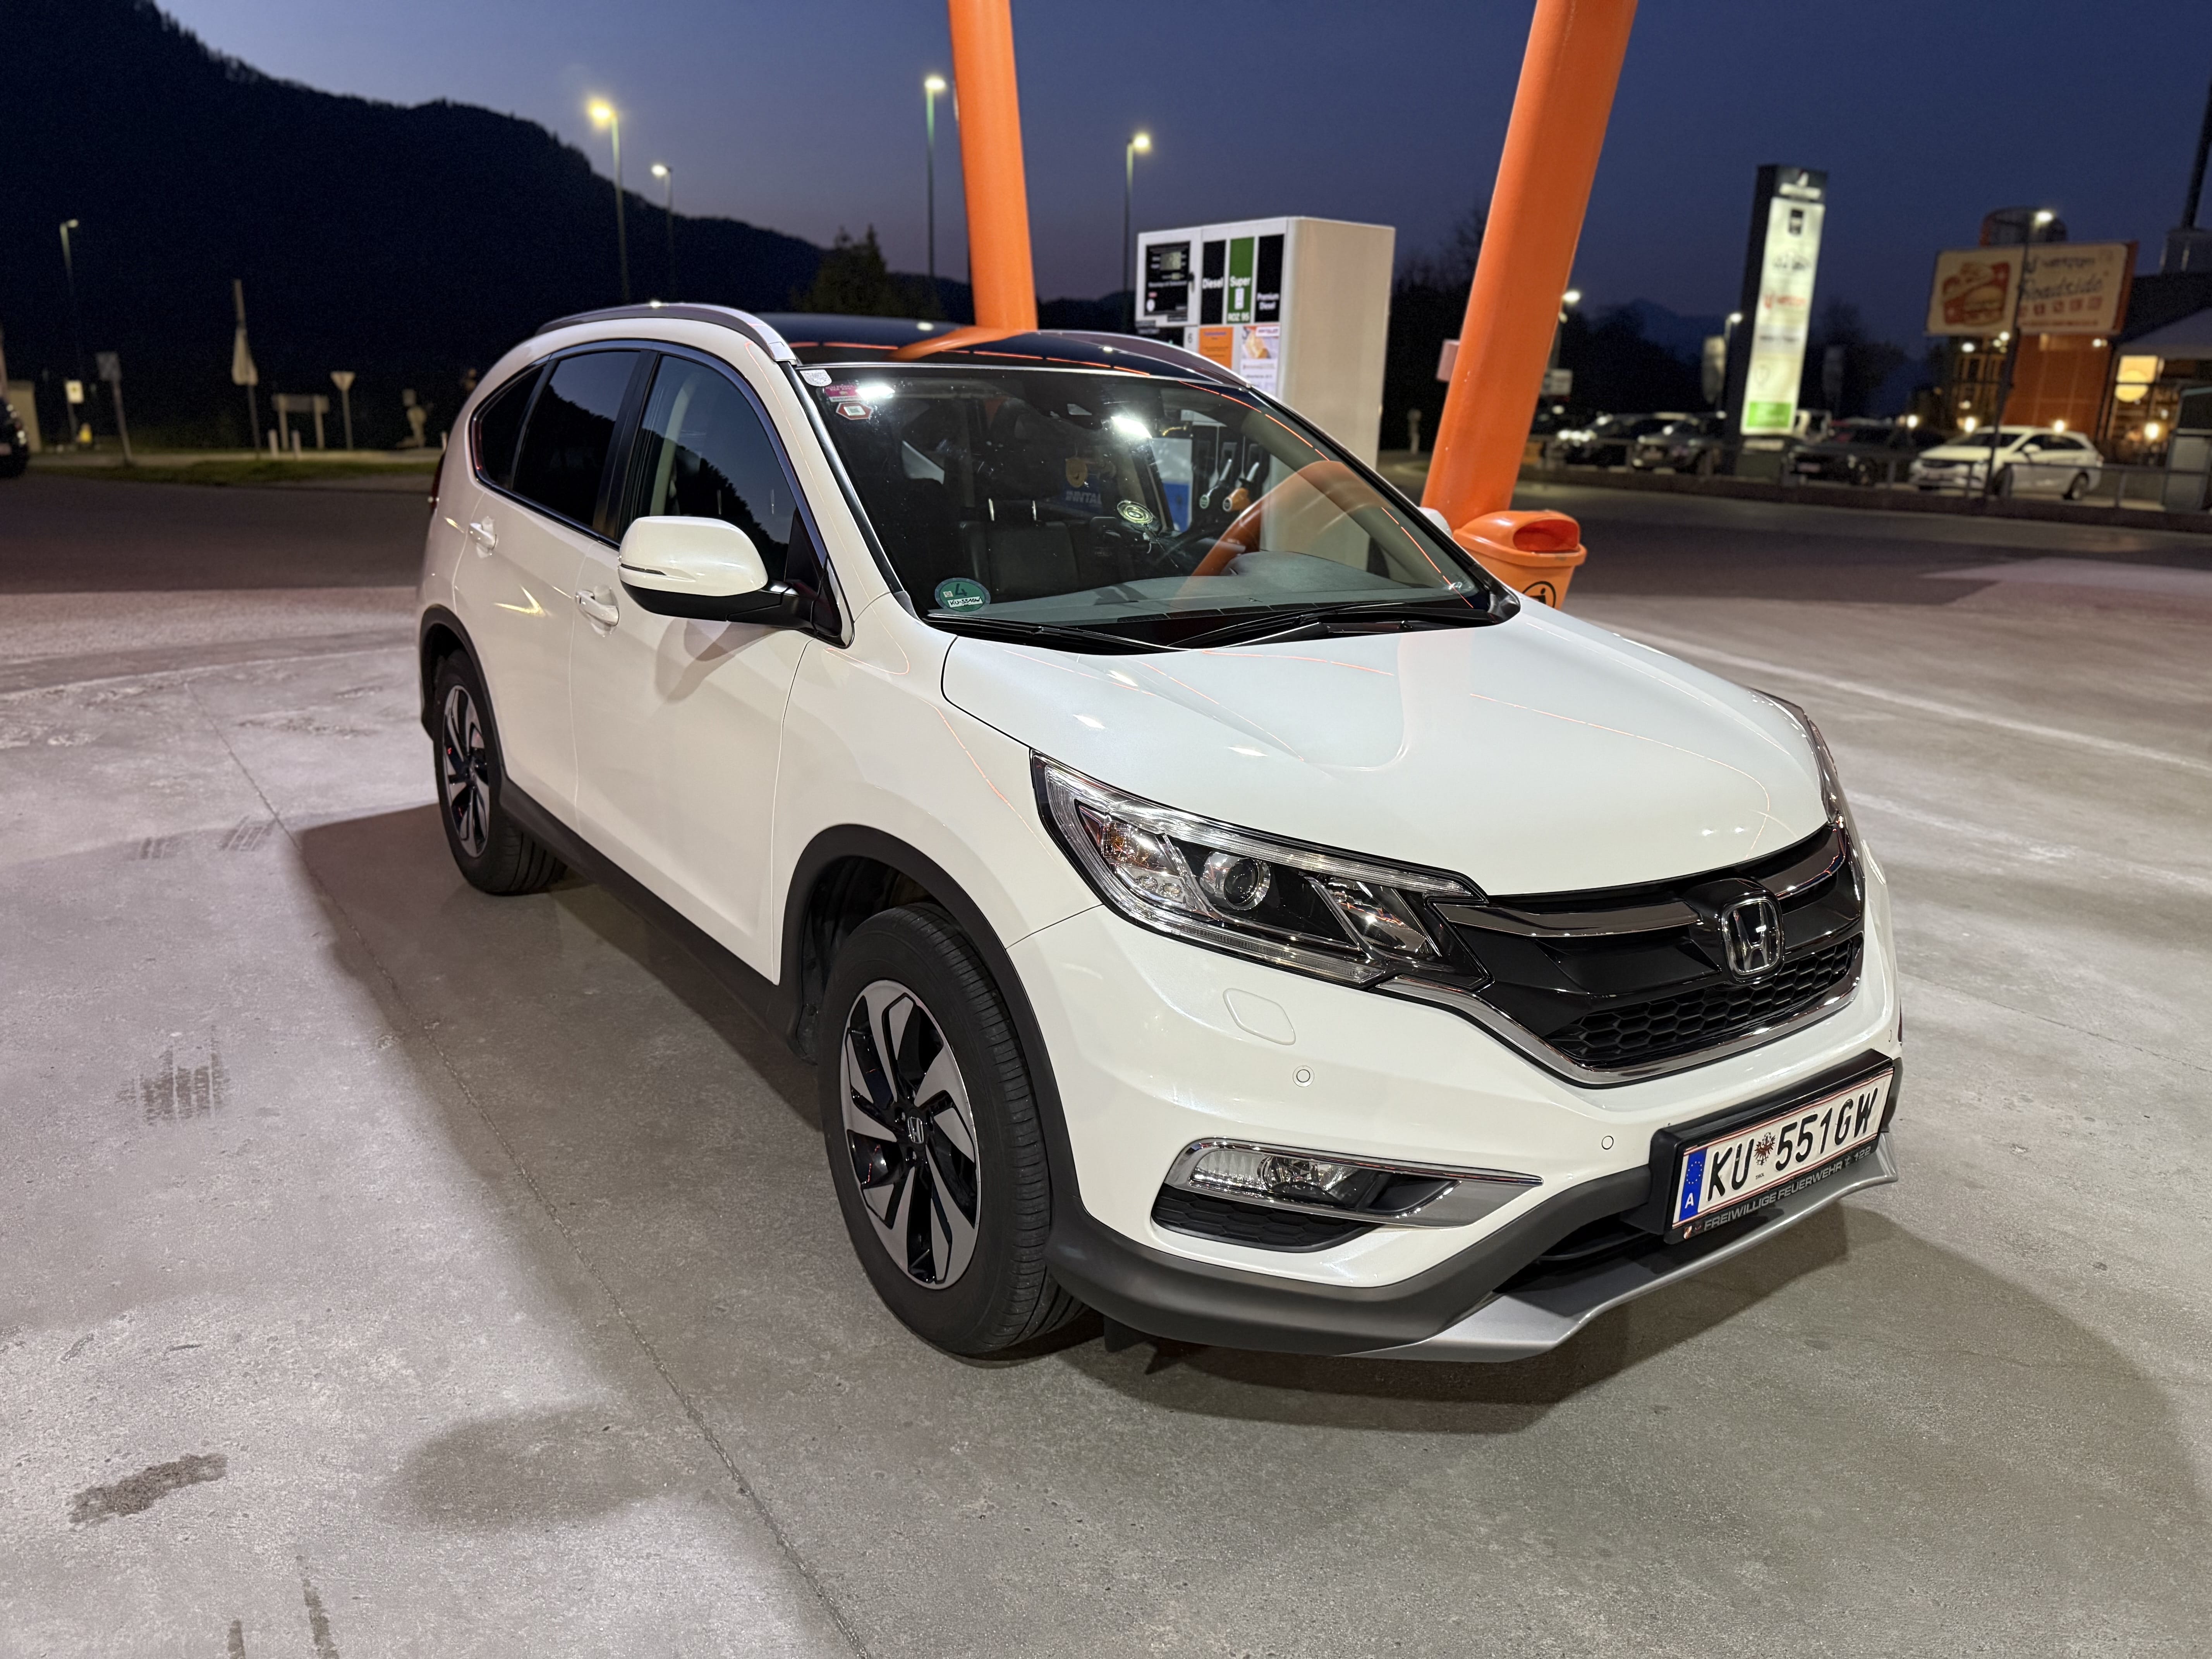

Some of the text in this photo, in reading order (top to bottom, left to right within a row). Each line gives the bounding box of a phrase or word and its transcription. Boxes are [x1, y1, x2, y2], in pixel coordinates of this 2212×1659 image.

[1202, 277, 1224, 289] Diesel
[1230, 276, 1251, 288] Super
[1259, 302, 1276, 310] Diesel
[1228, 312, 1250, 322] ROZ 95
[1188, 333, 1193, 343] 6
[955, 583, 967, 596] 4
[1707, 1087, 1878, 1202] KU 551GW
[1704, 1192, 1777, 1231] FREIWILLIGE
[1778, 1161, 1843, 1200] FEUERWEHR
[1853, 1146, 1871, 1161] 122
[1685, 1192, 1694, 1209] A
